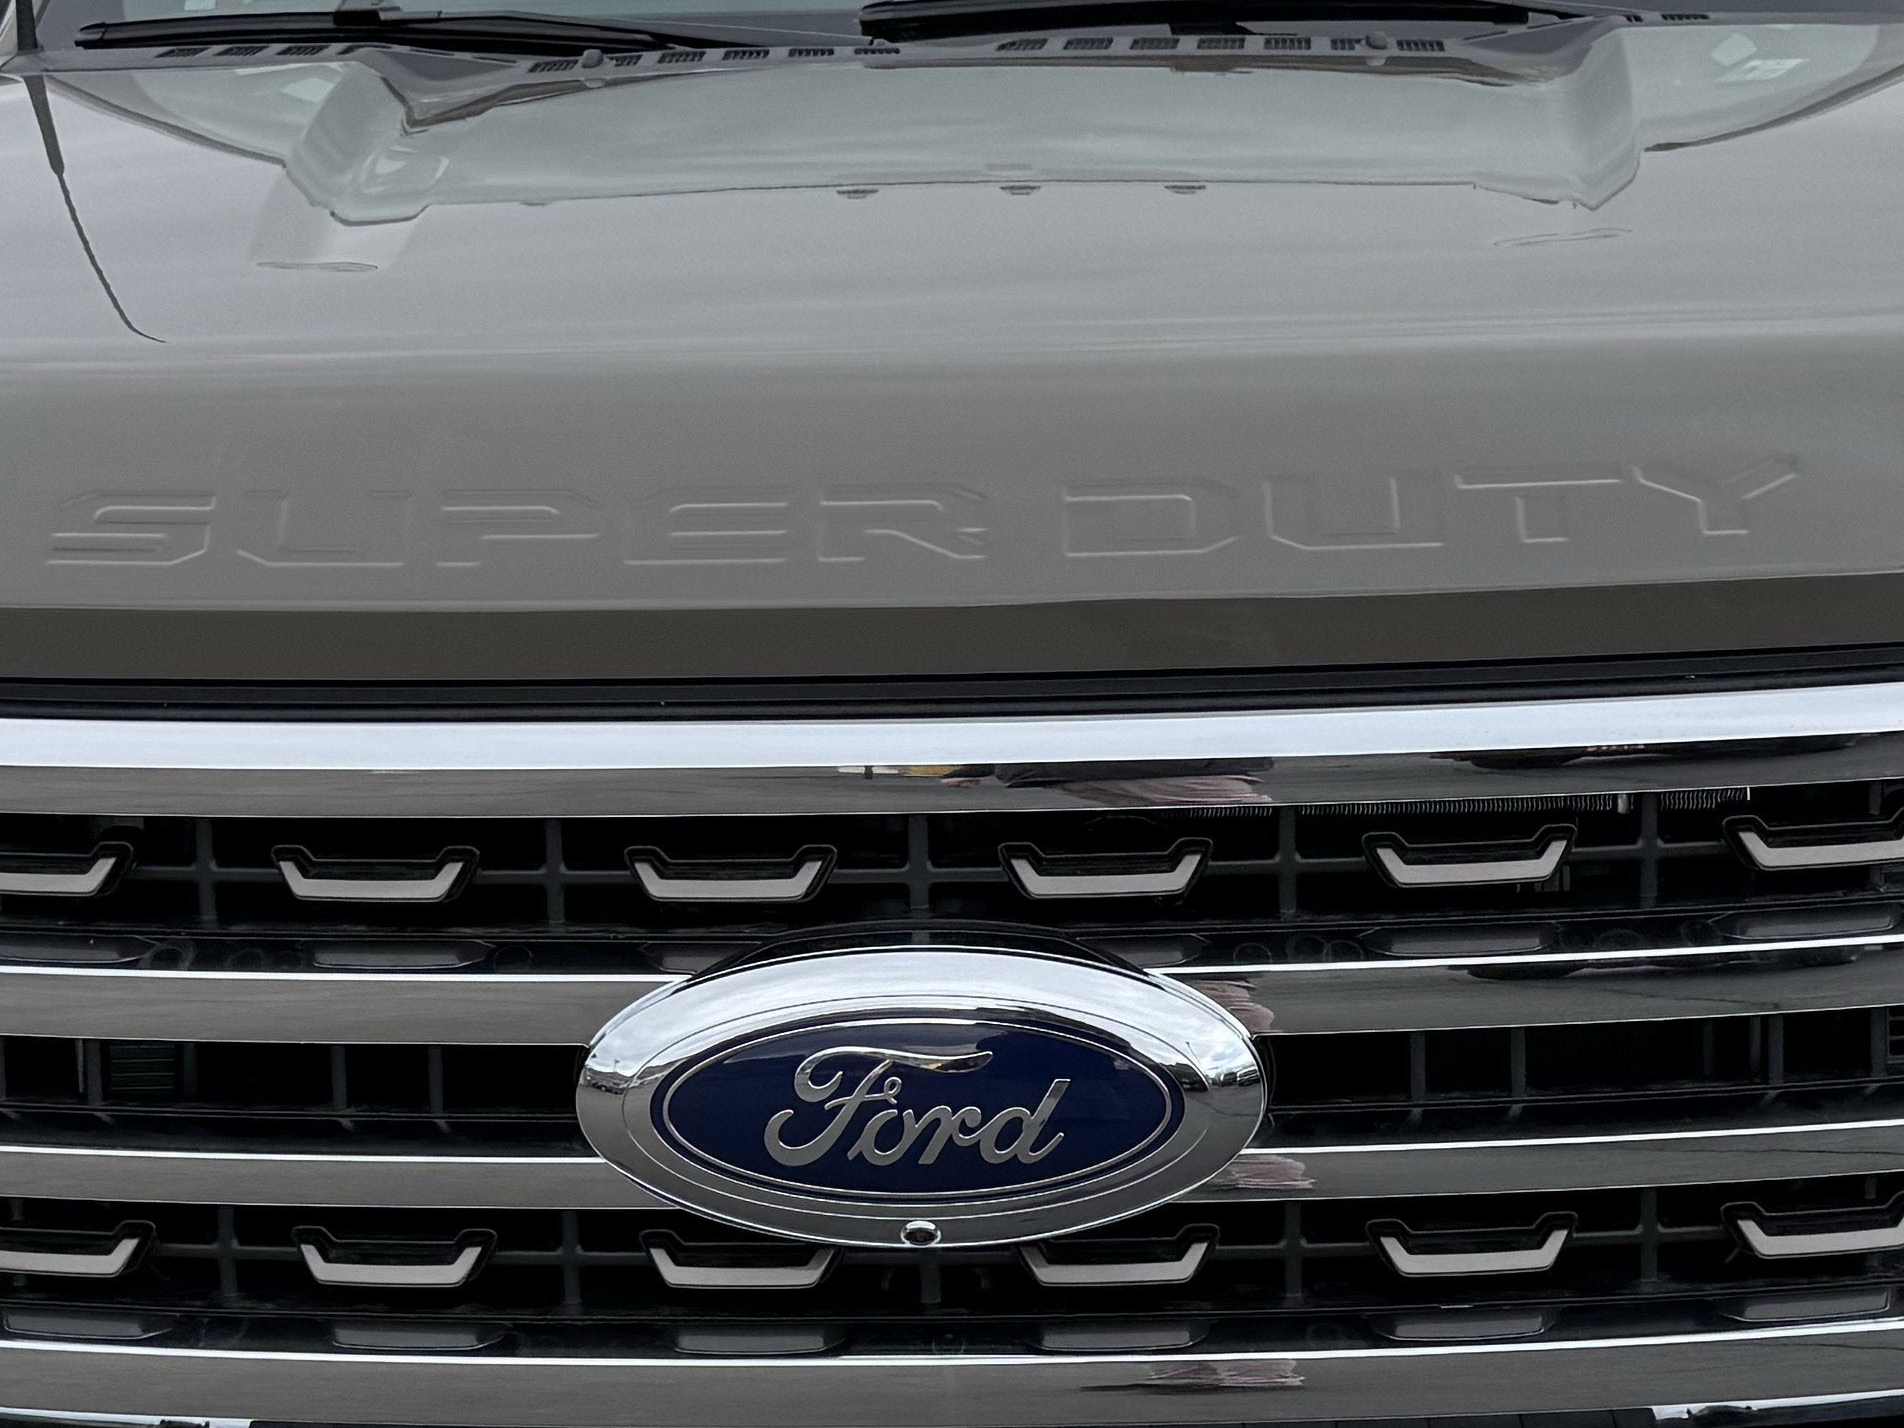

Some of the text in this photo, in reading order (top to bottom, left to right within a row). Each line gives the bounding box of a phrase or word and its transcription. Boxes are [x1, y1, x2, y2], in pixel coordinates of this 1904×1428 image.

[46, 453, 1800, 568] SUPER DUTY
[764, 1046, 1071, 1167] Ford
